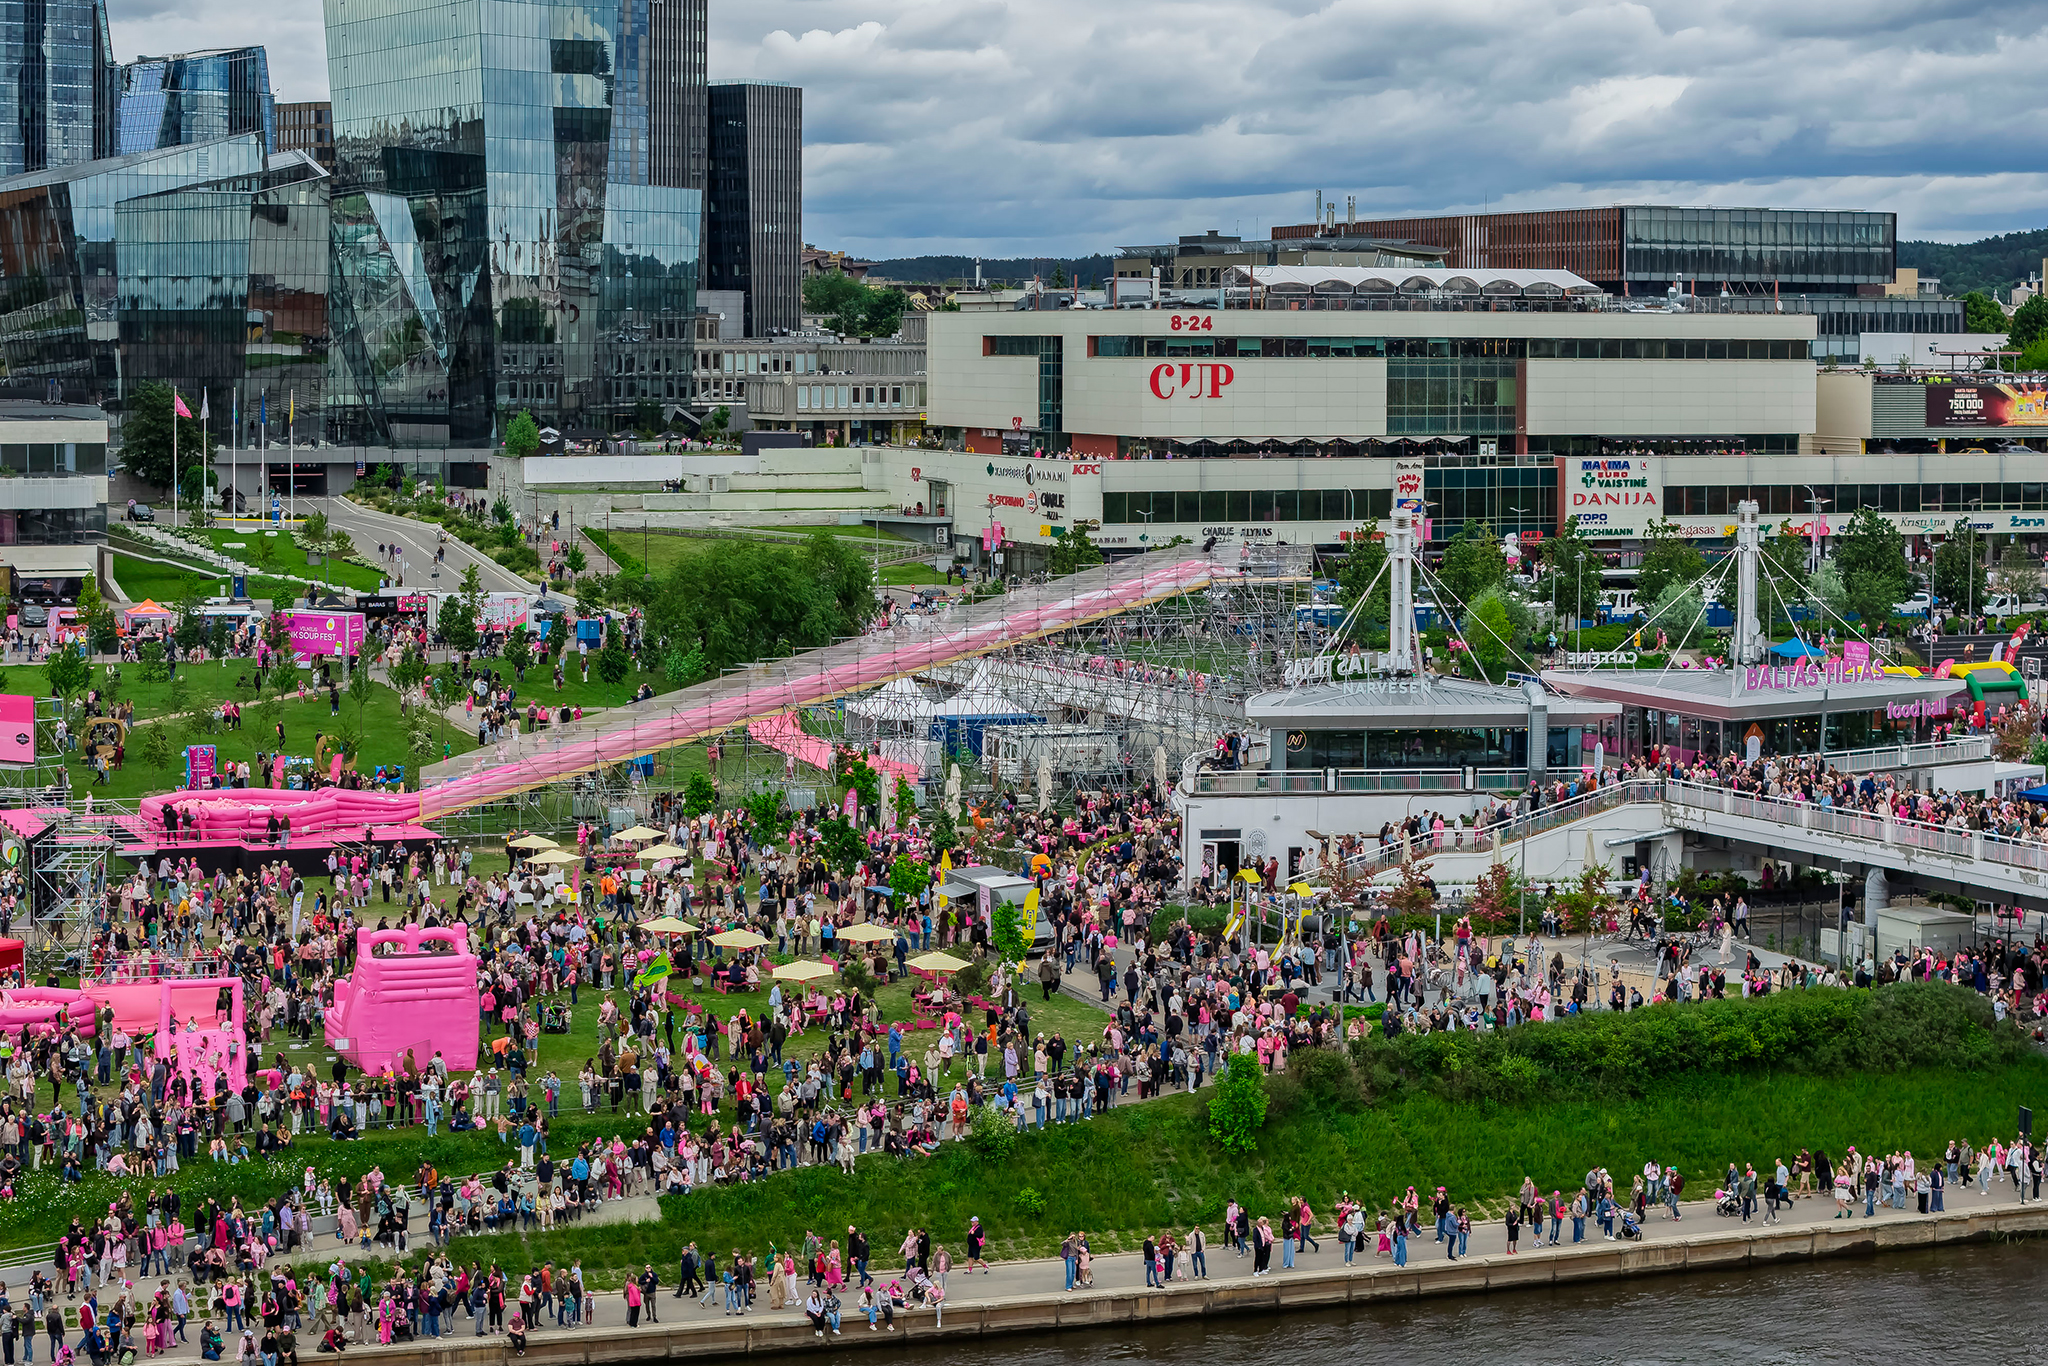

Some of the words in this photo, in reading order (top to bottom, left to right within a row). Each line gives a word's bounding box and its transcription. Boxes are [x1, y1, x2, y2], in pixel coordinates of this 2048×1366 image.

[1170, 315, 1213, 331] 8-24
[1149, 363, 1234, 400] CUP
[1948, 399, 1965, 409] 750
[1966, 399, 1983, 409] 000
[1072, 464, 1101, 475] KFC
[1582, 460, 1630, 471] MAXIMA
[1397, 474, 1421, 483] CANDY
[1597, 476, 1648, 488] VAISTINĖ
[1573, 492, 1656, 506] DANIJA
[1577, 513, 1608, 521] TOPO
[1202, 527, 1235, 536] CHARLIE
[1576, 528, 1633, 537] DEICHMANN
[298, 631, 320, 641] SOUP
[320, 633, 337, 642] FEST
[1745, 664, 1819, 691] BALTAS
[1822, 658, 1886, 685] TILTAS
[1342, 682, 1432, 694] NARVESEN
[1887, 699, 1920, 719] food
[1921, 697, 1948, 716] hall
